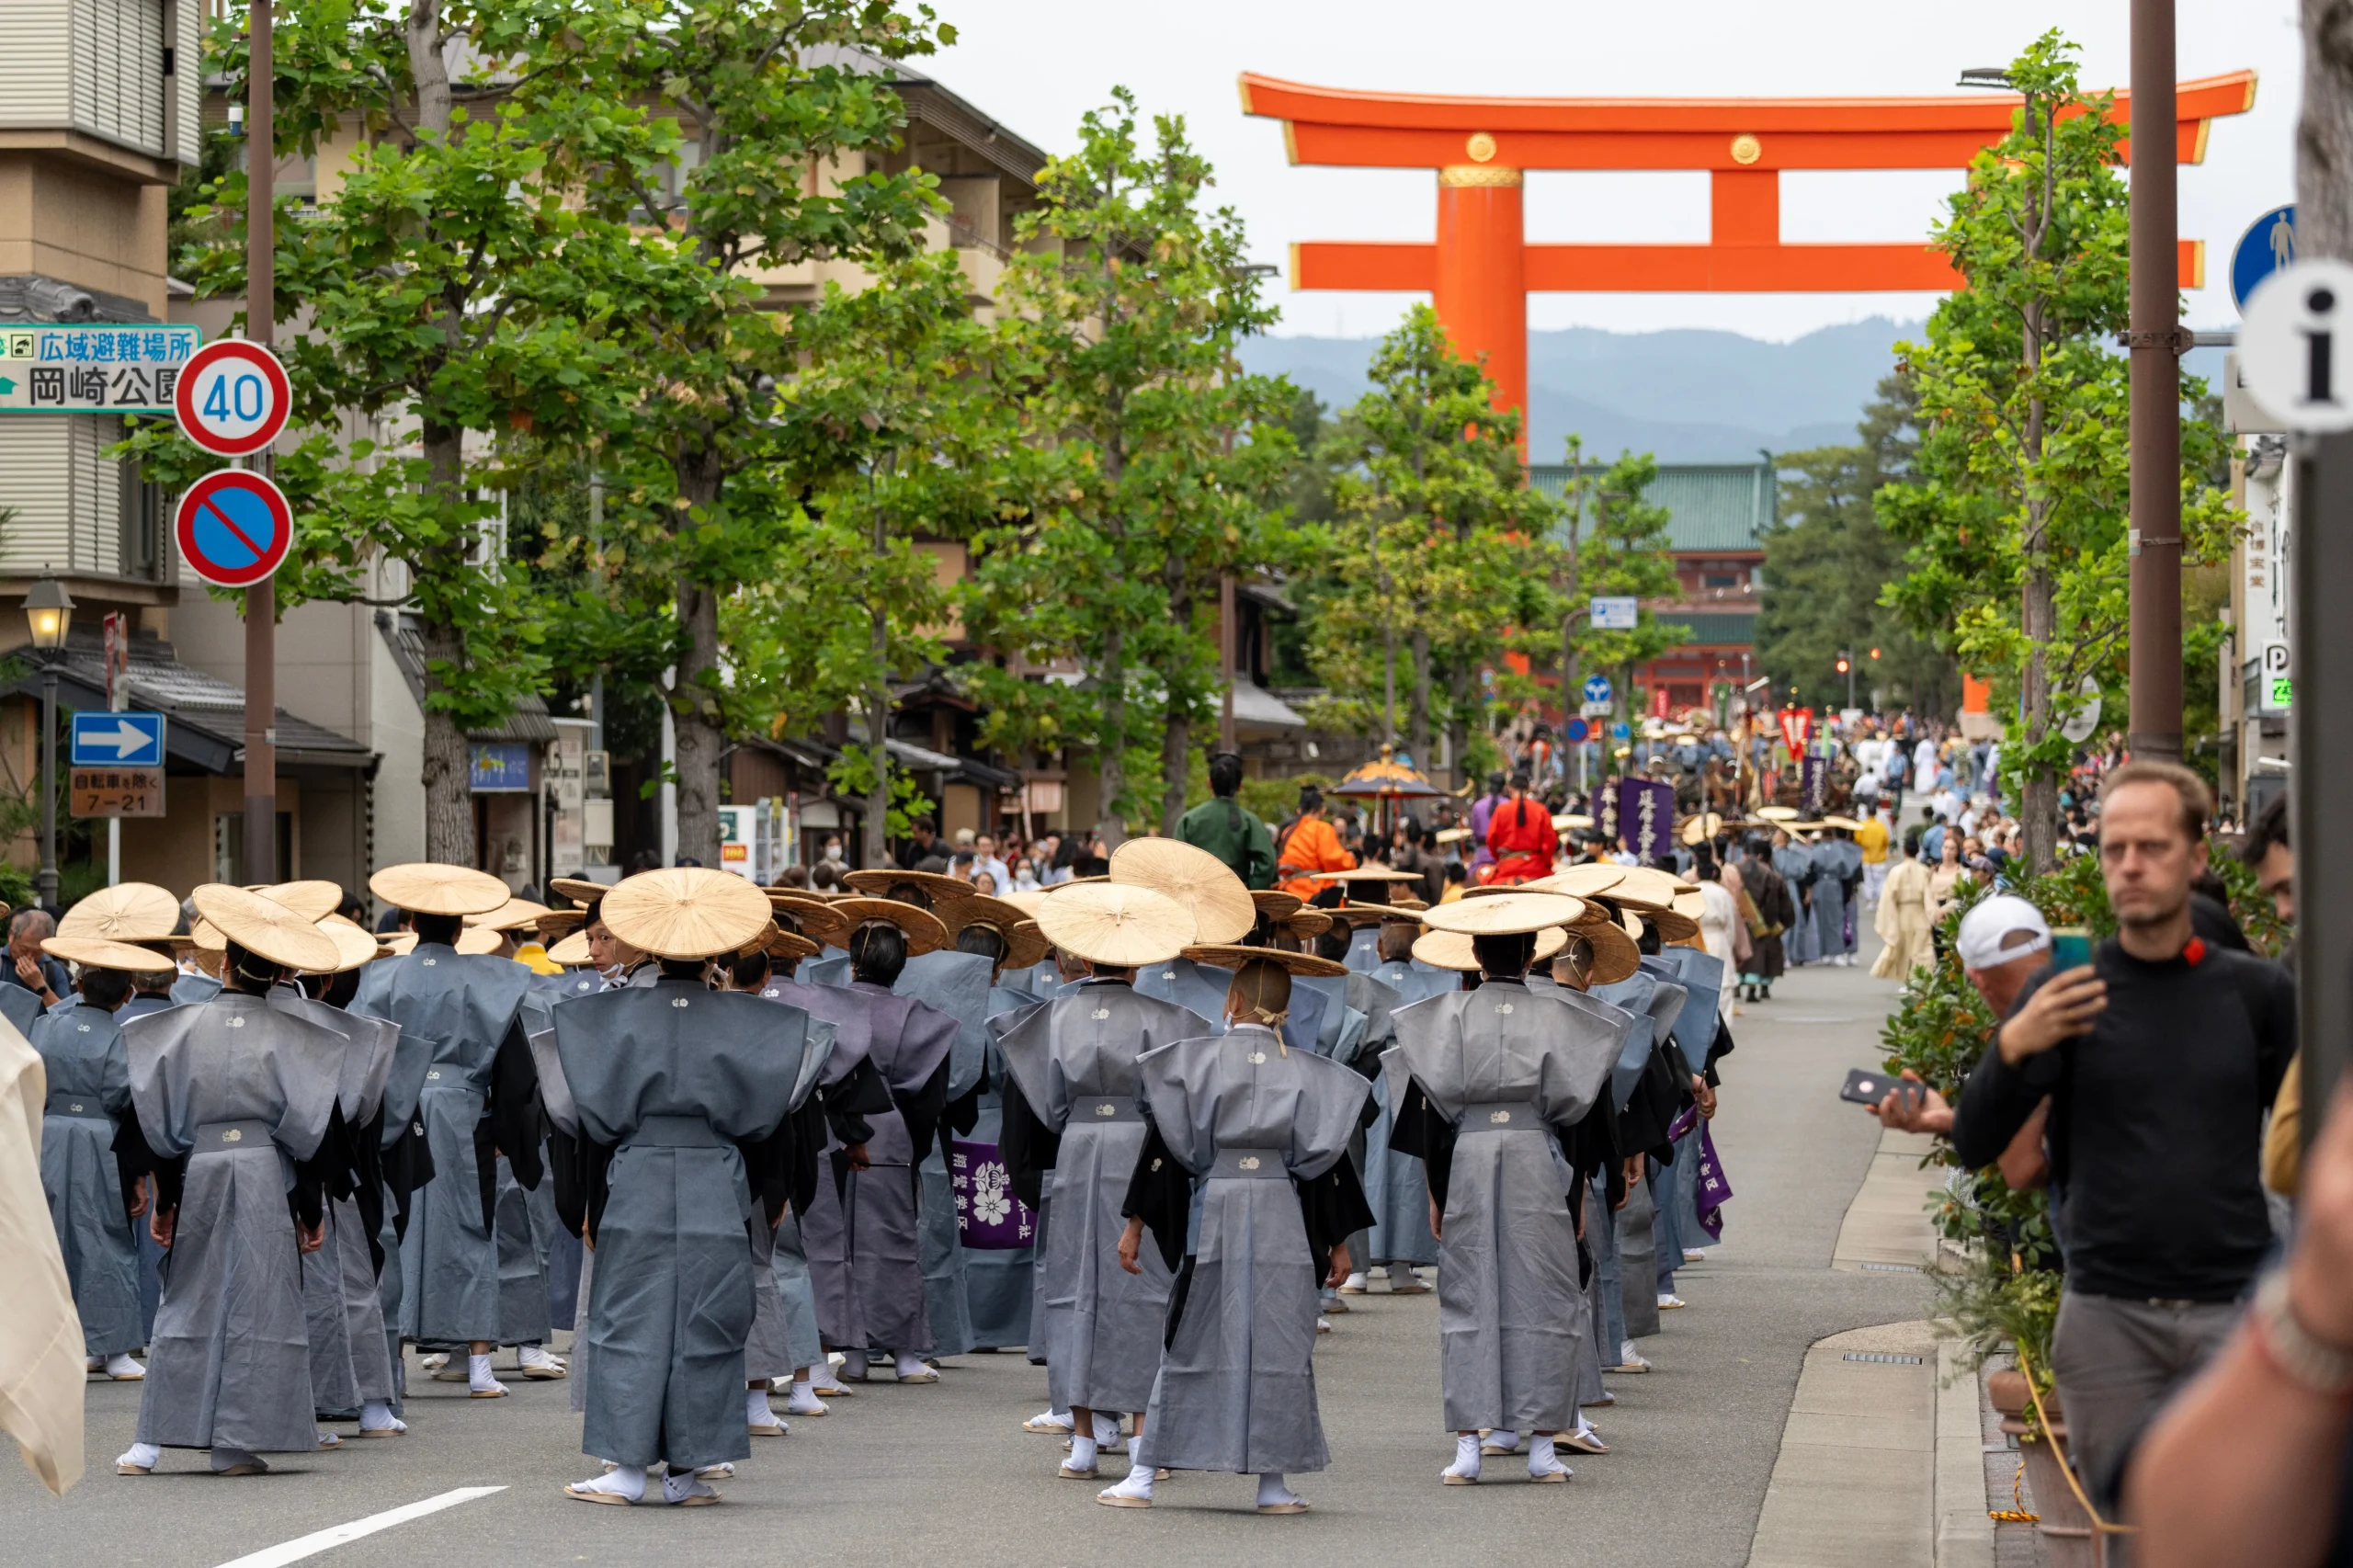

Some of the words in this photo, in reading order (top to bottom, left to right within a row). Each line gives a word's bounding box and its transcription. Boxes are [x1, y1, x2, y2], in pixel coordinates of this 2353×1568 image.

[40, 332, 193, 362] 広域避難場所
[29, 366, 179, 405] 岡崎公園
[203, 373, 264, 422] 40
[2267, 644, 2290, 672] P
[74, 773, 158, 790] 自転車を除く
